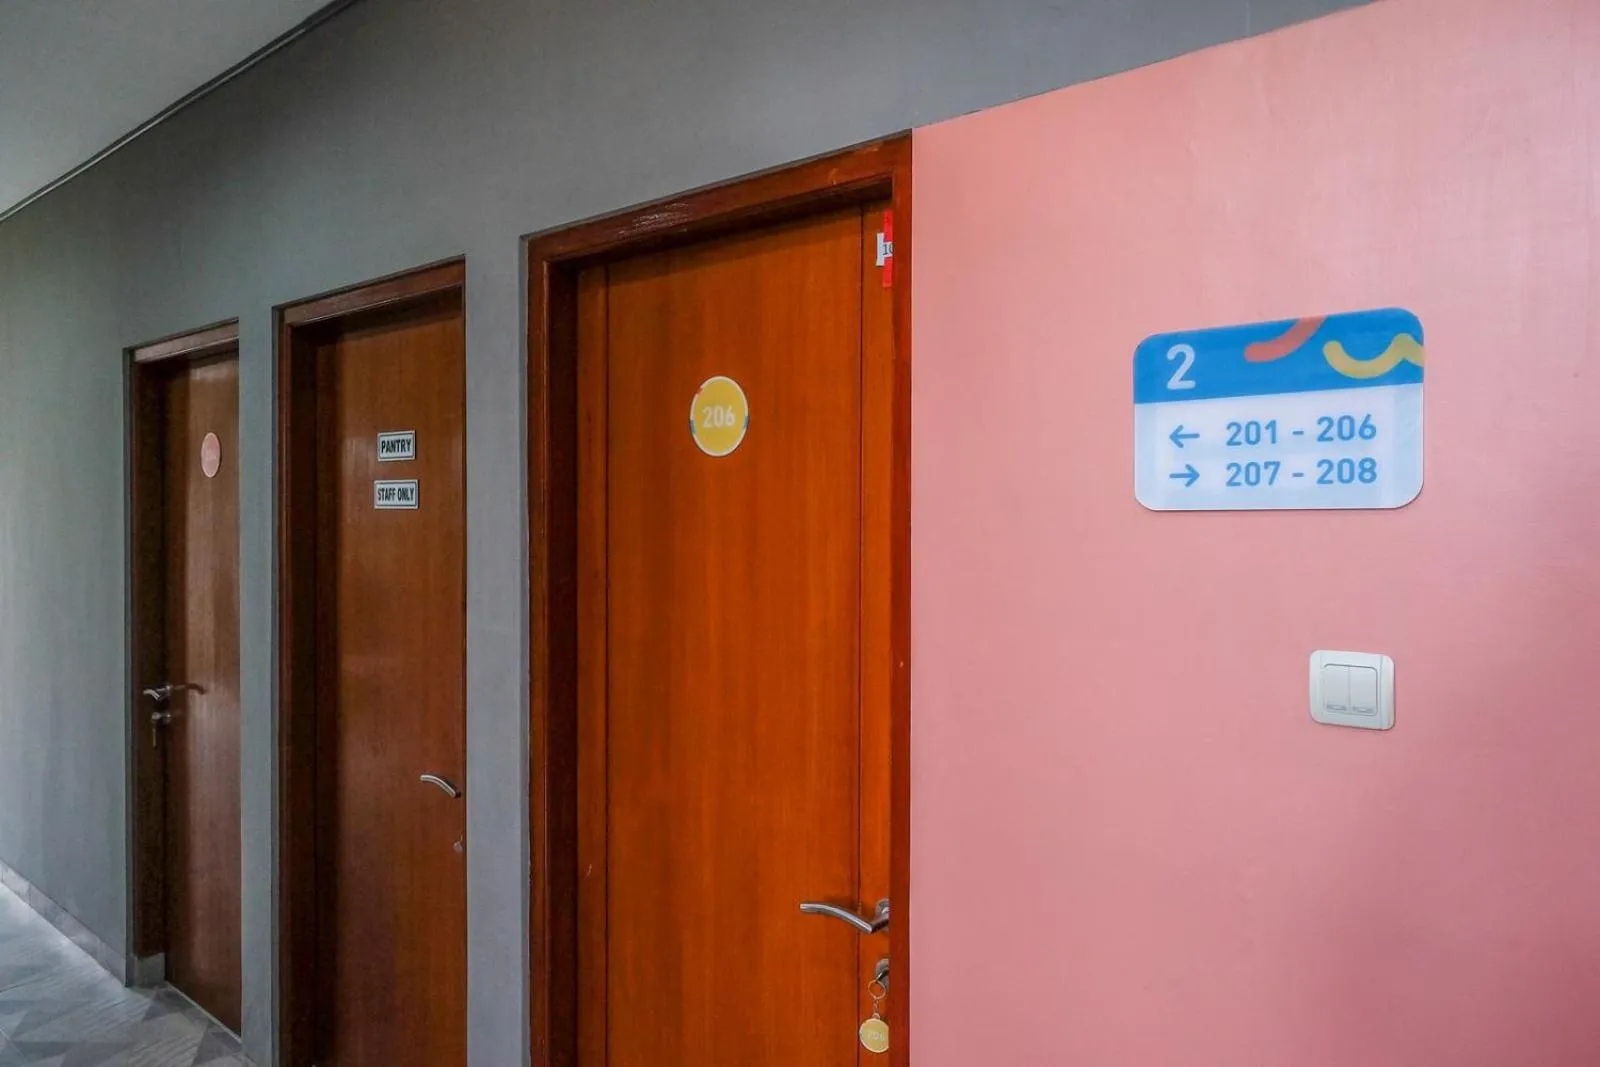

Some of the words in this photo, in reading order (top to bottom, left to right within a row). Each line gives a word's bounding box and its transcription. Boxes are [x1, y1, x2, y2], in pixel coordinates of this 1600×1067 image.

[1166, 344, 1196, 391] 2
[702, 404, 736, 429] 206
[1225, 419, 1278, 447] 201
[1316, 414, 1377, 443] 206
[381, 438, 412, 453] PANTRY
[1225, 460, 1281, 487] 207
[1316, 457, 1377, 485] 208
[377, 487, 396, 501] STAFF
[397, 487, 415, 501] ONLY
